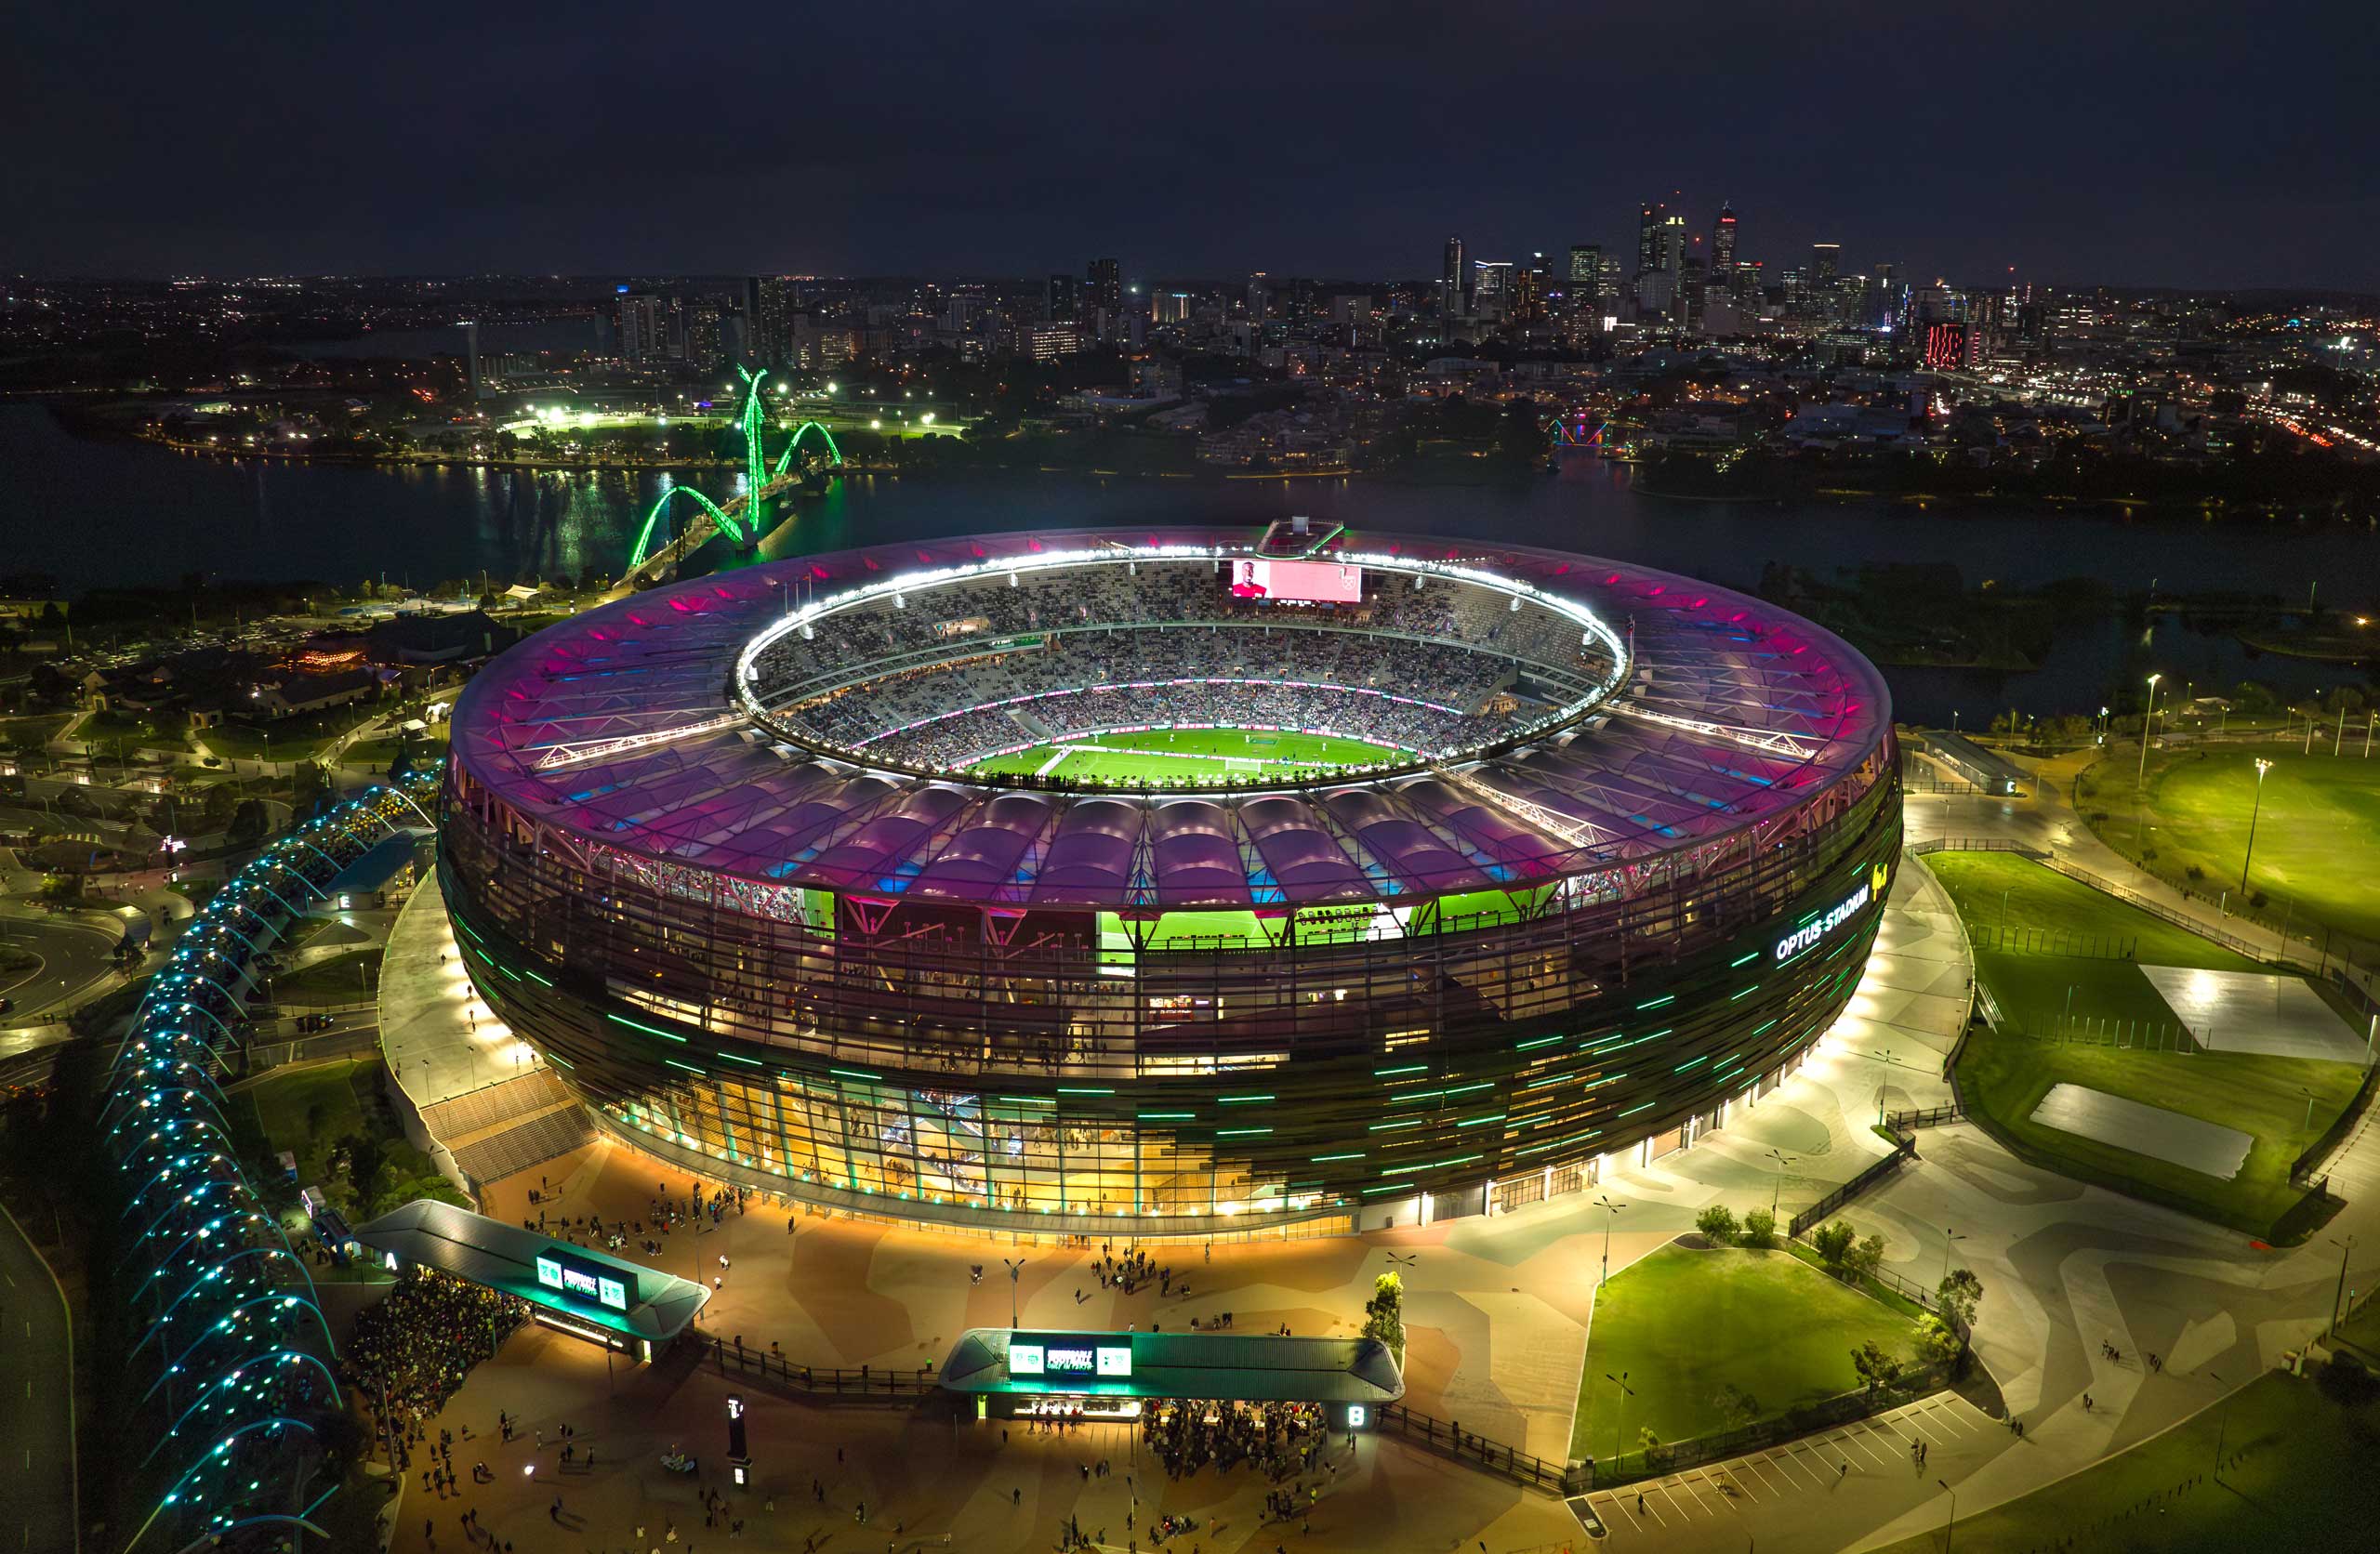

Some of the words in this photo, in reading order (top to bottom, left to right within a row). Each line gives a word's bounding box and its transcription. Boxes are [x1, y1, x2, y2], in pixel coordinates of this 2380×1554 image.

[1776, 919, 1822, 960] OPTUS
[1824, 884, 1870, 932] STADIUM
[385, 1252, 398, 1271] A
[1348, 1406, 1365, 1426] B
